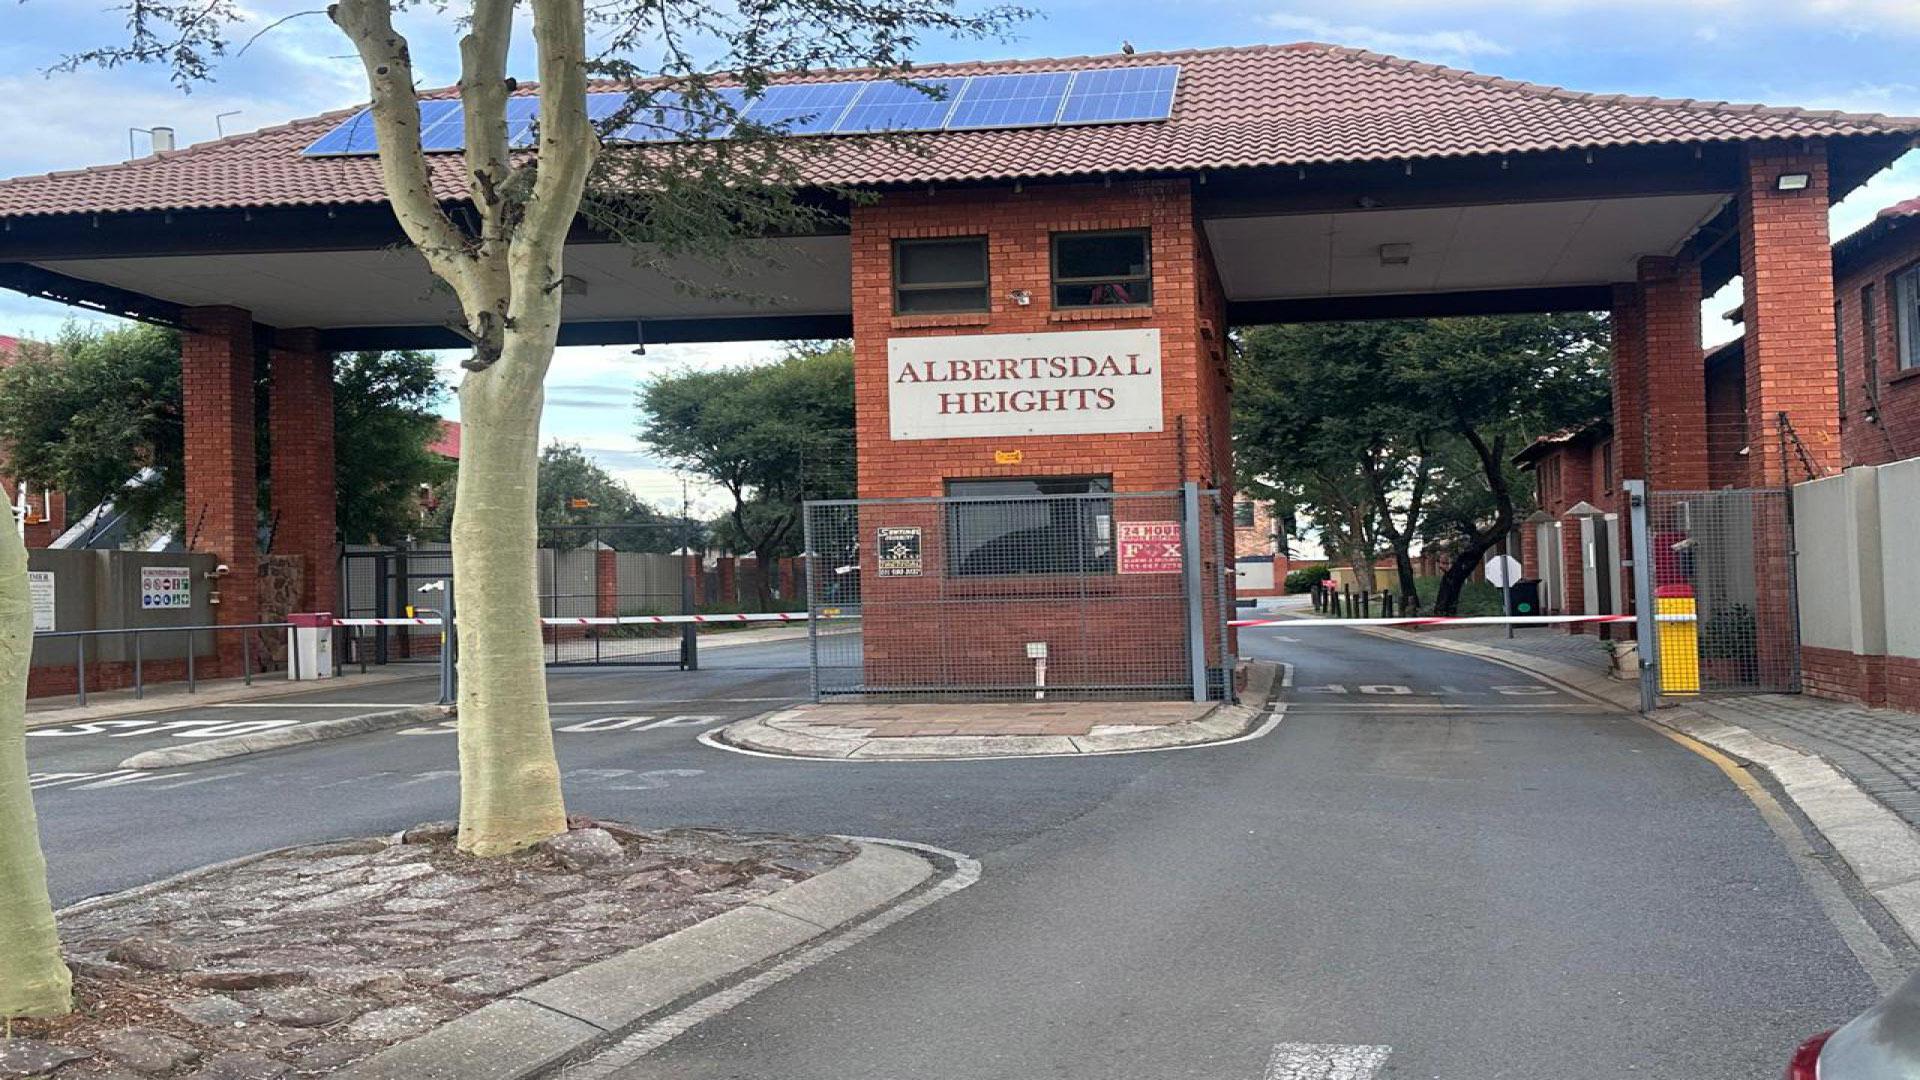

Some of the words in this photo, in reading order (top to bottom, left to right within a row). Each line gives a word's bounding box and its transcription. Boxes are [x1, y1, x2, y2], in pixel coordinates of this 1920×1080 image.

[896, 354, 1152, 383] ALBERTSDAL
[938, 387, 1115, 414] HEIGHTS
[1123, 527, 1139, 535] 24
[1144, 526, 1181, 535] HOUR
[26, 719, 299, 737] STO
[396, 715, 727, 736] SOP
